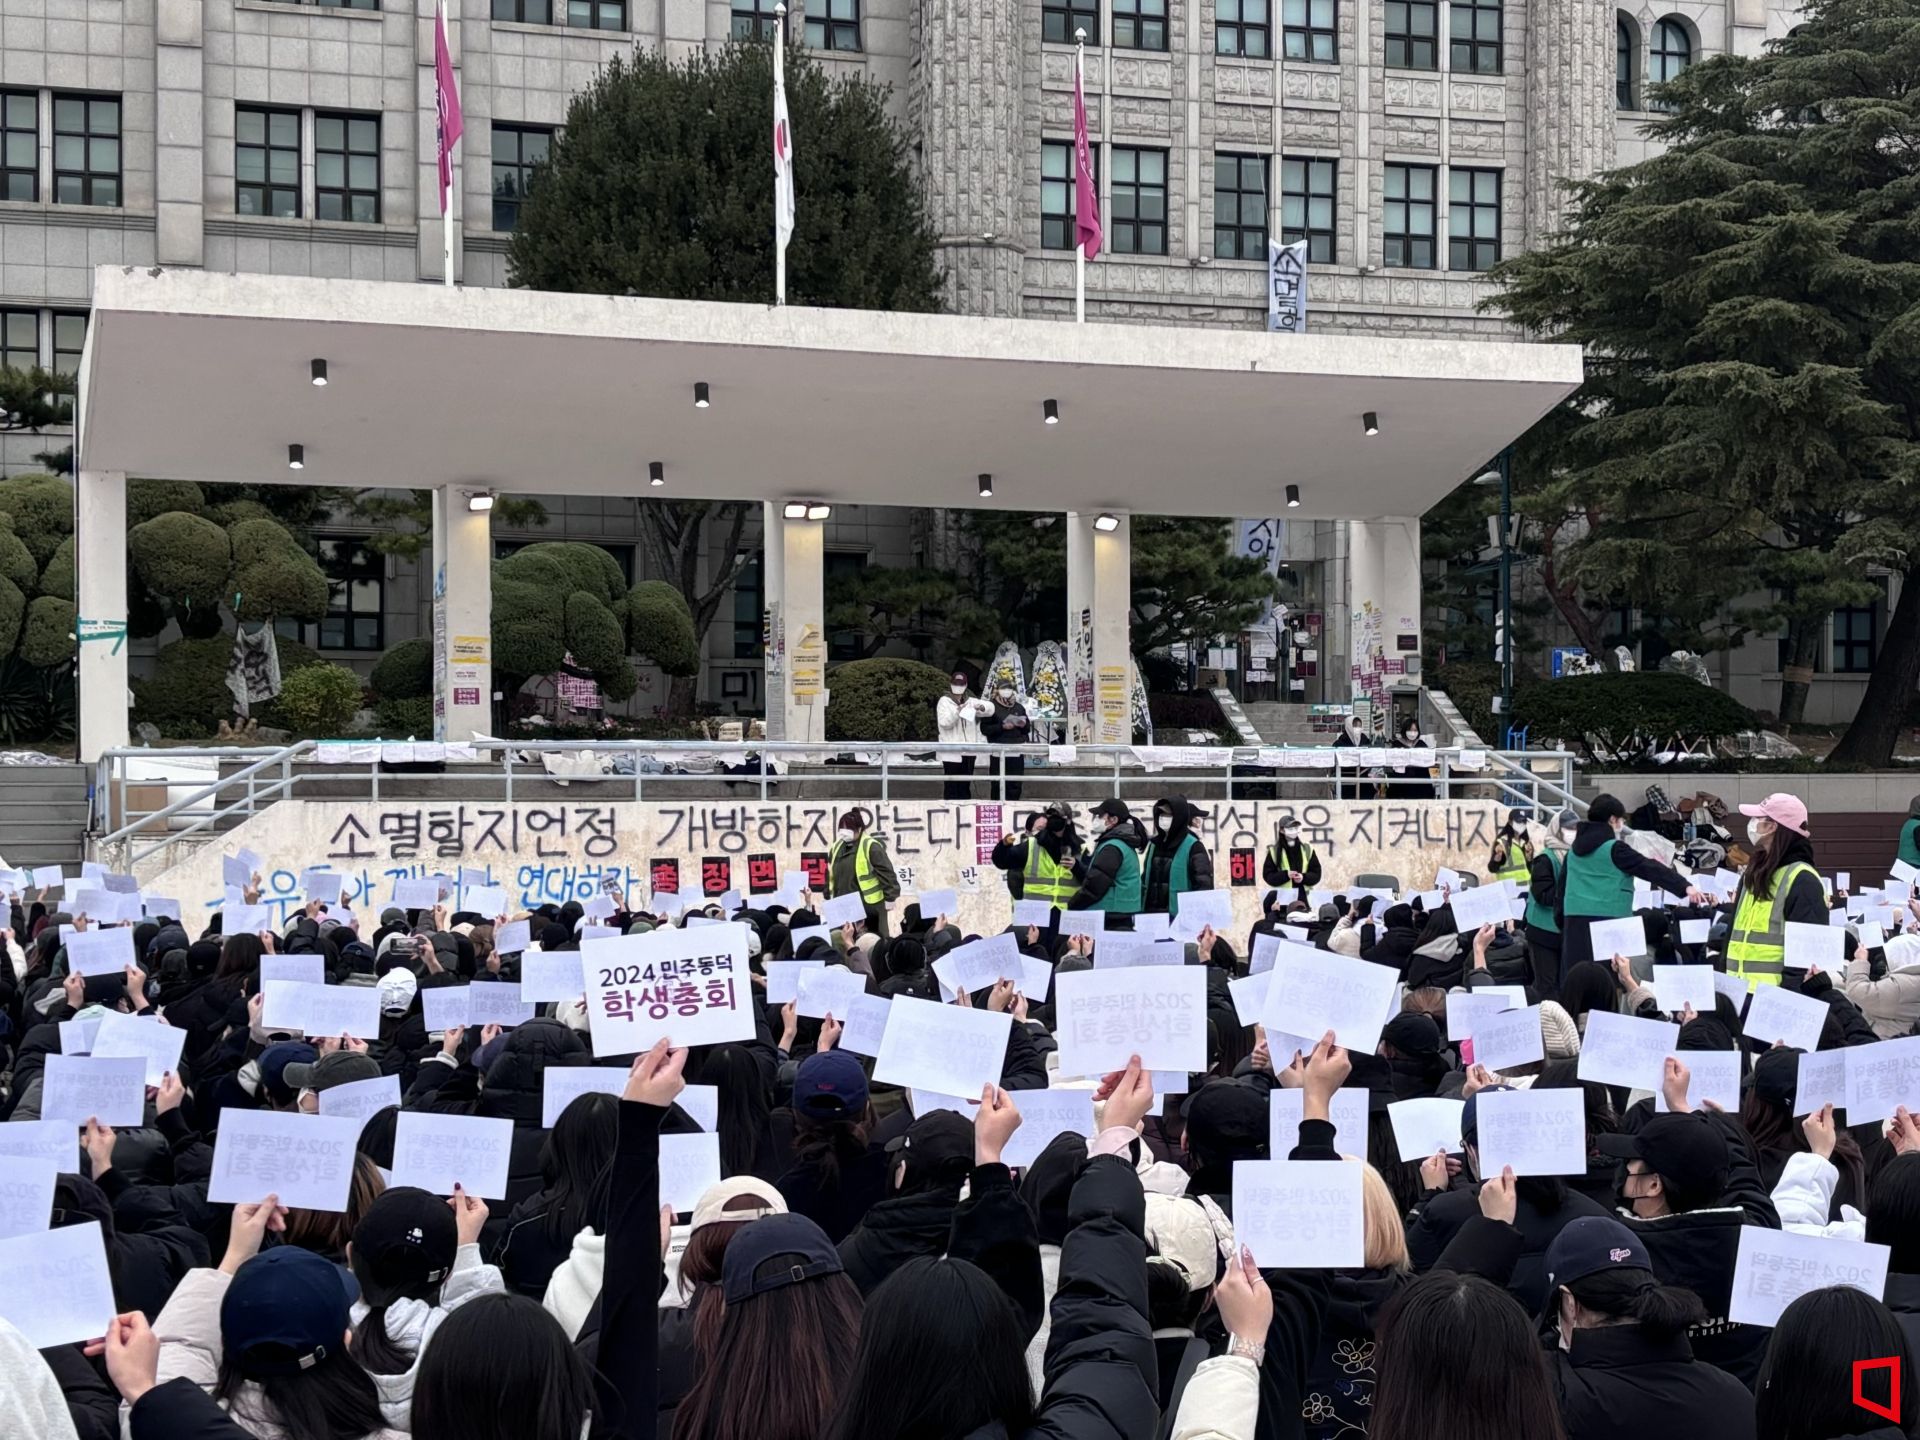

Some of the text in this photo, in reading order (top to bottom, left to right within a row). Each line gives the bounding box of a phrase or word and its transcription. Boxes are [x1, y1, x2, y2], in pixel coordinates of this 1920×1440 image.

[327, 806, 619, 858] 소멸할지언정
[516, 862, 639, 909] 연대하자
[599, 953, 733, 988] 2024 민주동덕
[602, 977, 737, 1022] 학생총회
